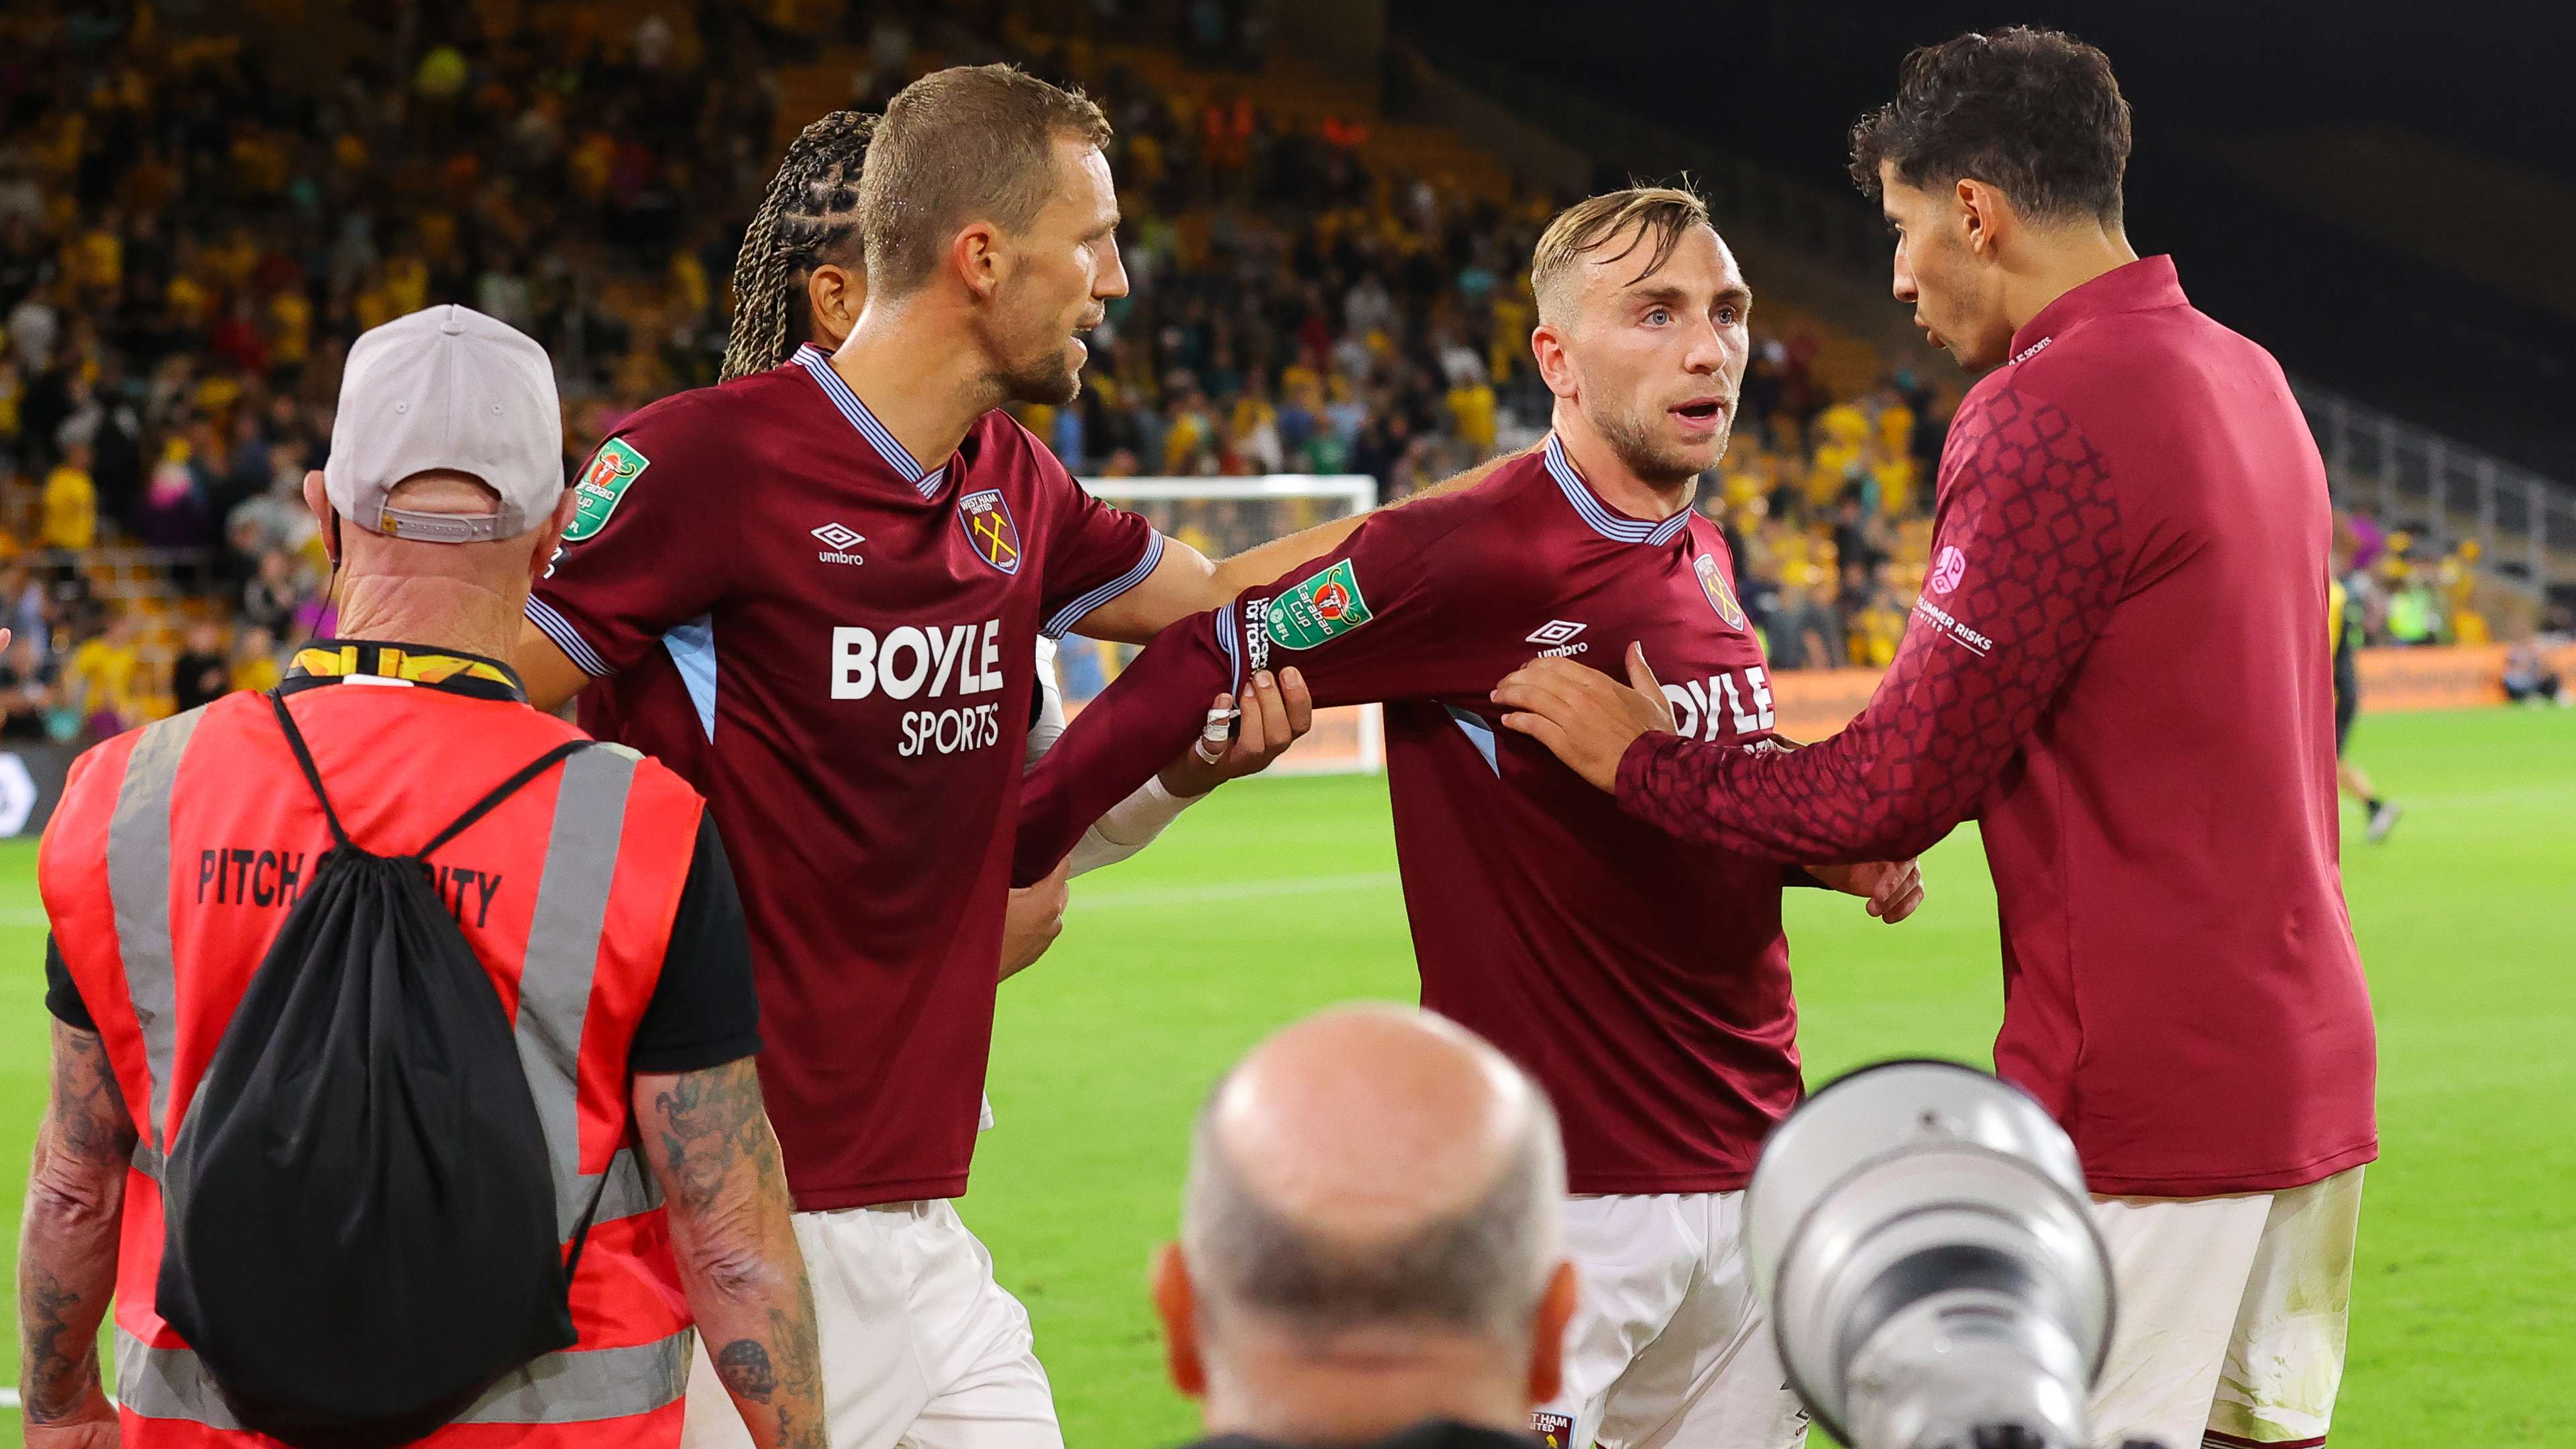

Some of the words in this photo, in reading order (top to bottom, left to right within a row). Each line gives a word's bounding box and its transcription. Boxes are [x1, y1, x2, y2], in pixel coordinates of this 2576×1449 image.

[960, 496, 979, 511] WEST
[978, 493, 998, 505] HAM
[970, 503, 992, 515] UNITED
[819, 550, 863, 566] umbro
[1289, 600, 1312, 628] Cup
[1297, 584, 1334, 635] Carabao
[1275, 623, 1291, 641] EFL
[1954, 623, 1992, 650] RISKS
[830, 619, 1004, 700] BOYLE
[1245, 623, 1261, 675] racis
[1660, 666, 1775, 742] OYLE
[898, 702, 999, 757] SPORTS
[198, 847, 304, 908] PITCH
[1530, 1422, 1555, 1432] ITED
[1541, 1414, 1567, 1428] HAM
